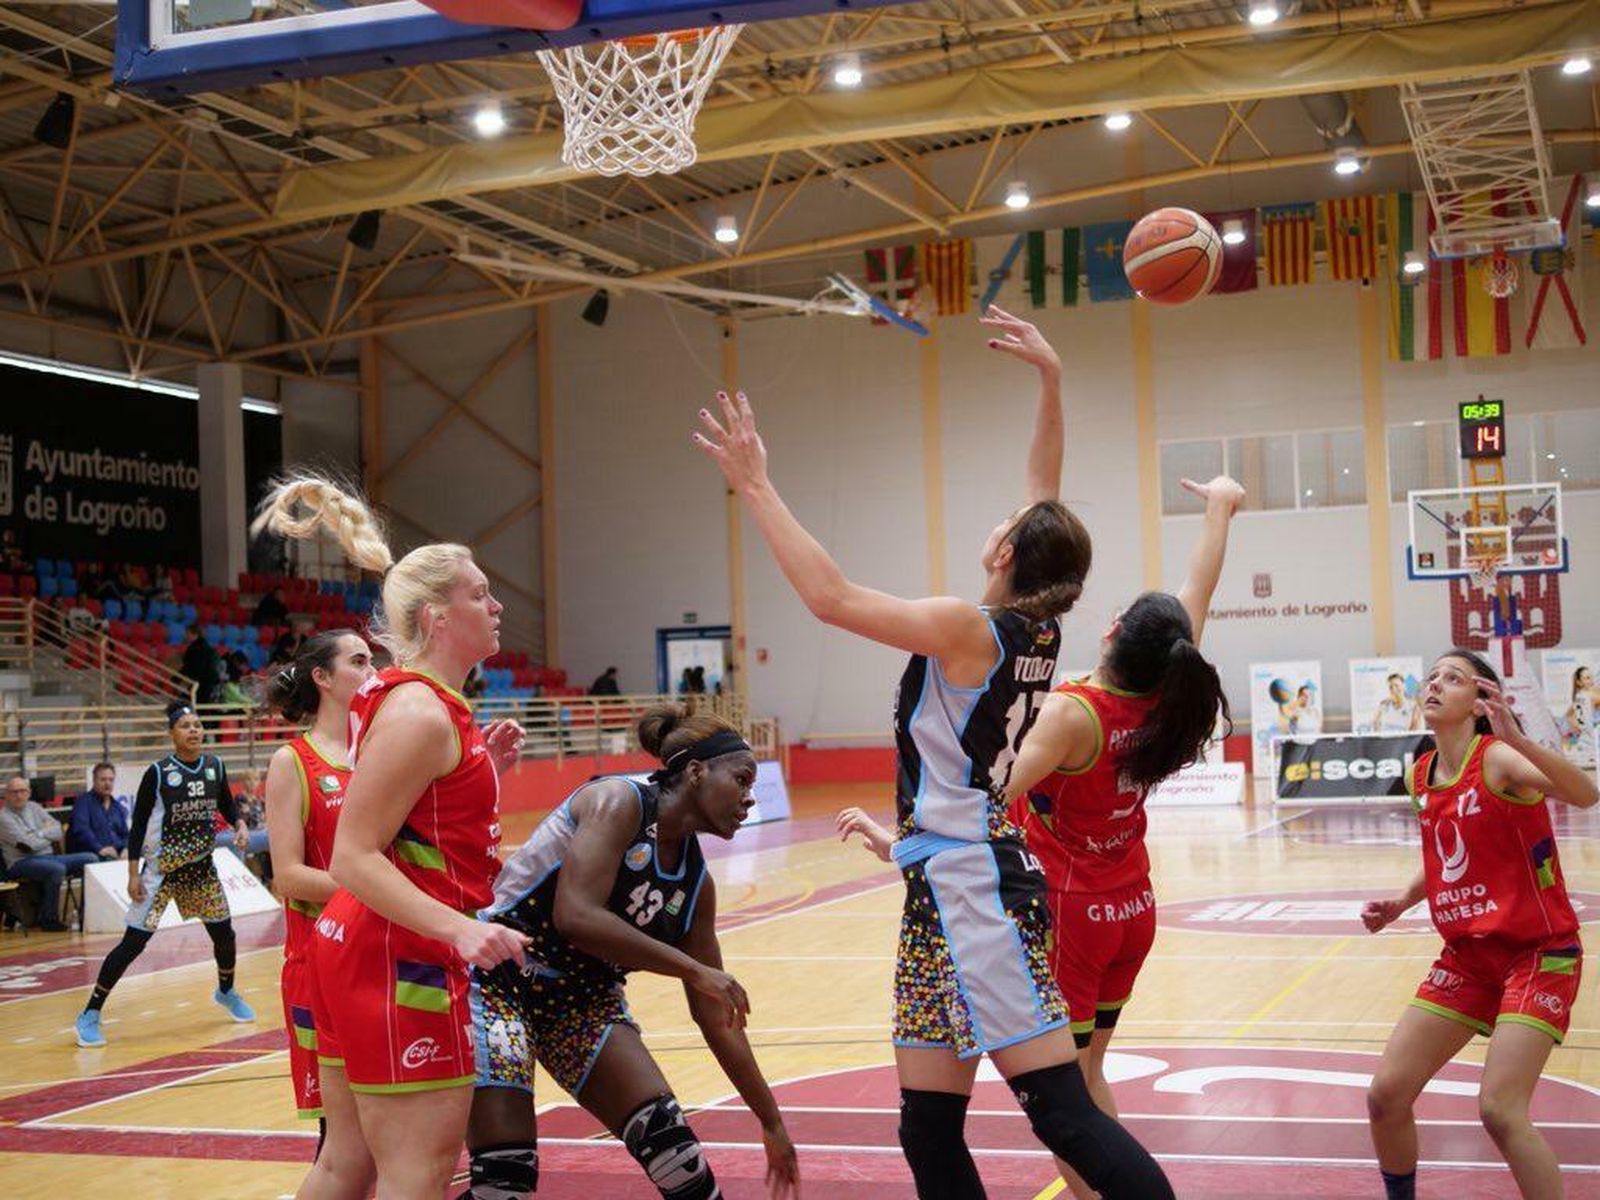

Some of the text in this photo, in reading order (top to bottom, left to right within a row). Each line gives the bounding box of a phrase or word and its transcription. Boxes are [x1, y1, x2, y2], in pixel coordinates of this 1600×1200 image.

[1463, 403, 1500, 419] 05:39
[1478, 426, 1499, 451] 14
[26, 441, 200, 491] Ayuntamiento
[24, 485, 166, 535] de Logroño
[1282, 604, 1300, 617] de
[1305, 600, 1368, 618] Logroño
[187, 780, 205, 797] 32
[1457, 787, 1482, 817] 12
[625, 881, 664, 927] 43
[1436, 884, 1486, 906] GRUPO
[1435, 900, 1498, 923] HAFESA
